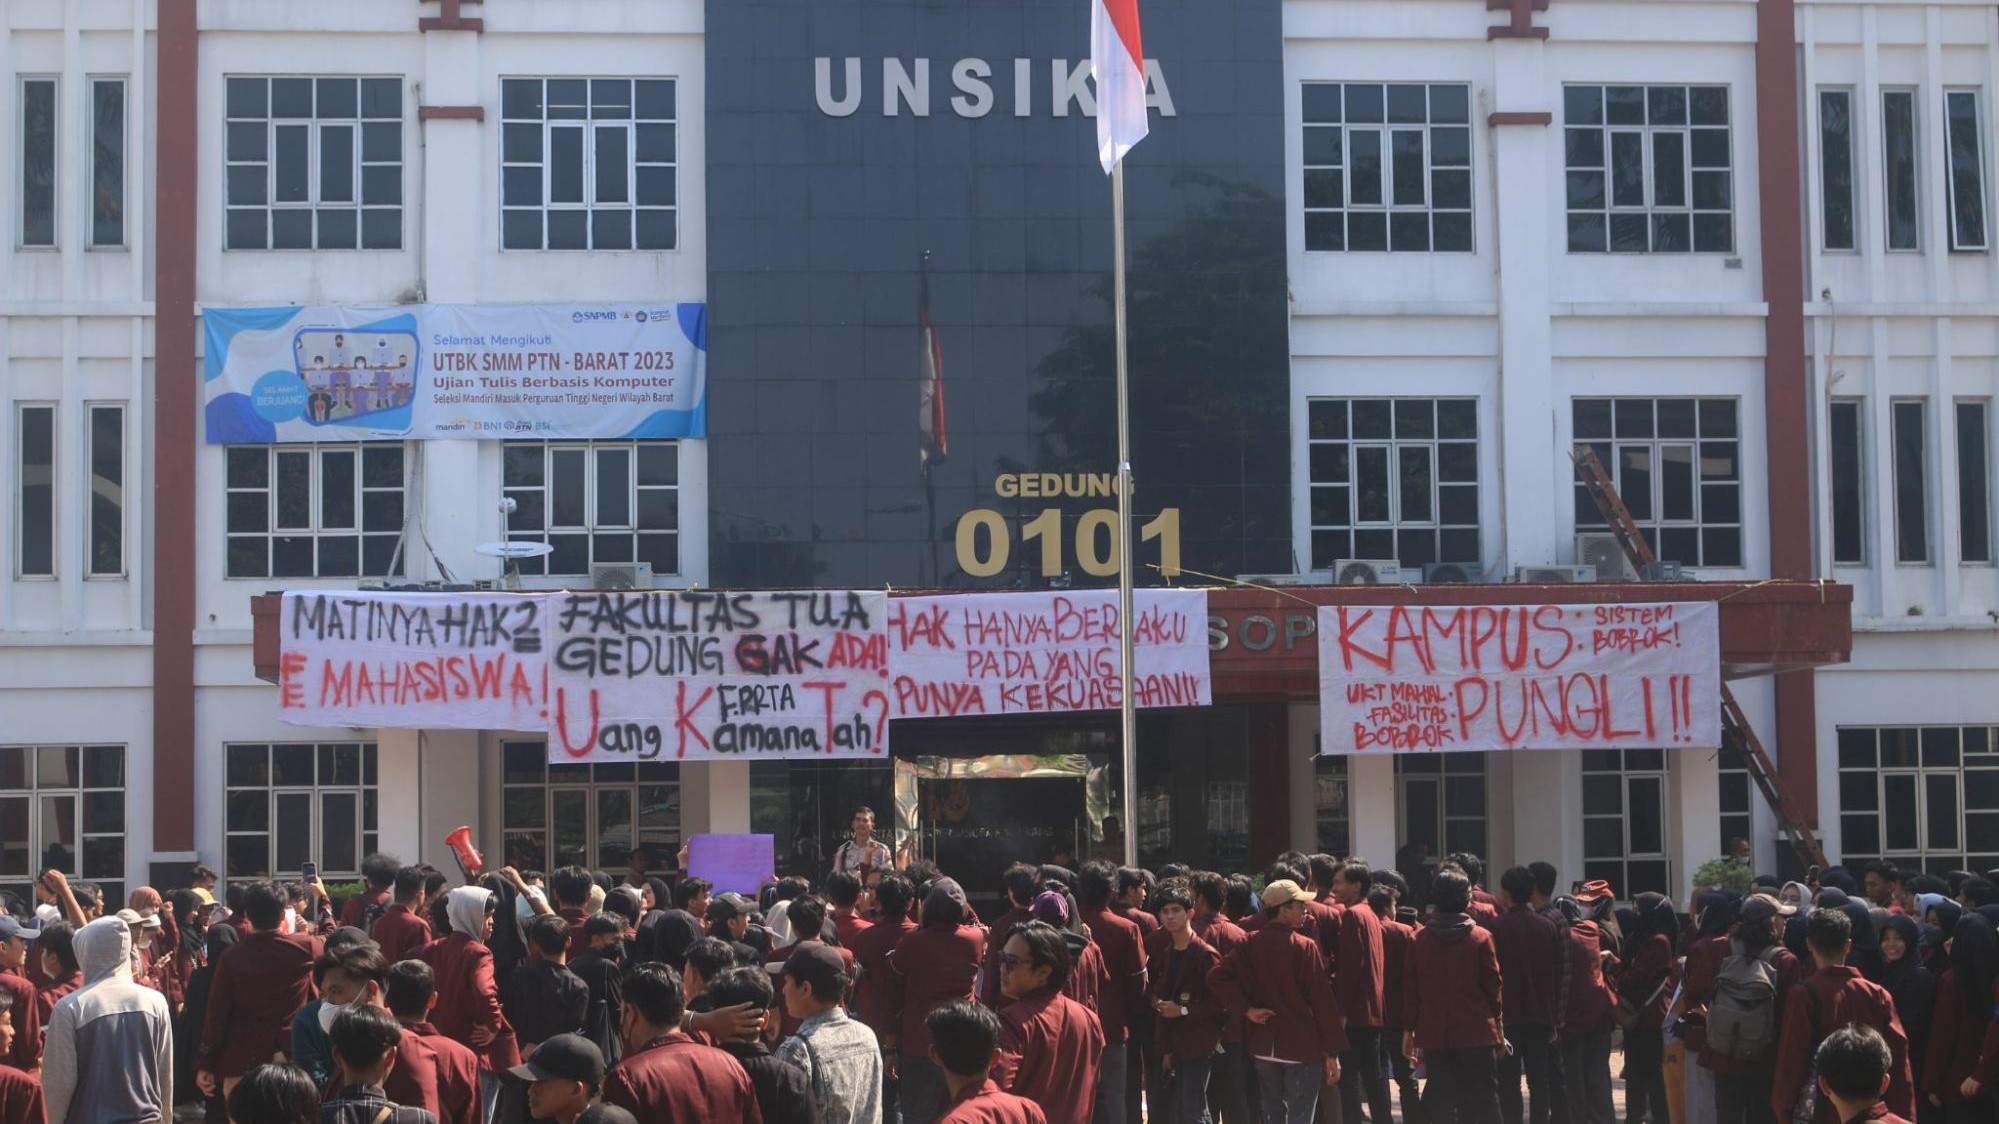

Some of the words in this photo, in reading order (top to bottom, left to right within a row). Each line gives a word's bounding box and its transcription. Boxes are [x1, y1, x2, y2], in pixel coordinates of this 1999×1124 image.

[433, 334, 486, 345] Selamat
[491, 334, 552, 348] Mengikuti
[433, 352, 477, 371] UTBK
[482, 352, 522, 371] SMM
[527, 352, 560, 371] PTN
[574, 352, 629, 370] BARAT
[634, 351, 674, 370] 2023
[433, 377, 474, 390] Ujian
[479, 376, 517, 388] Tulis
[522, 376, 589, 388] Berbasis
[594, 376, 675, 389] Komputer
[433, 394, 460, 404] Seleksi
[463, 394, 493, 403] Mandiri
[495, 394, 521, 403] Masuk
[523, 394, 563, 405] Perguruan
[566, 393, 590, 405] Tinggi
[592, 393, 617, 405] Negeri
[620, 393, 650, 404] Wilayah
[652, 393, 674, 403] Barat
[955, 508, 1181, 578] 0101
[560, 593, 760, 634] FAKULTAS
[771, 592, 871, 630] TUA
[888, 602, 956, 650] HAK
[964, 607, 1052, 648] HANYA
[1054, 597, 1187, 645] BERAKU
[1594, 605, 1674, 625] SISTEM
[556, 636, 725, 678] GEDUNG
[735, 633, 824, 676] GAK
[827, 632, 889, 679] ADA!
[966, 650, 1039, 679] PADA
[1043, 648, 1113, 681] YANG
[320, 653, 549, 718] MAHASISWA!
[893, 675, 986, 716] PUNYA
[1347, 683, 1386, 704] UKT
[556, 687, 662, 758] Uang
[674, 680, 822, 758] Kamana
[801, 681, 889, 754] Tah?
